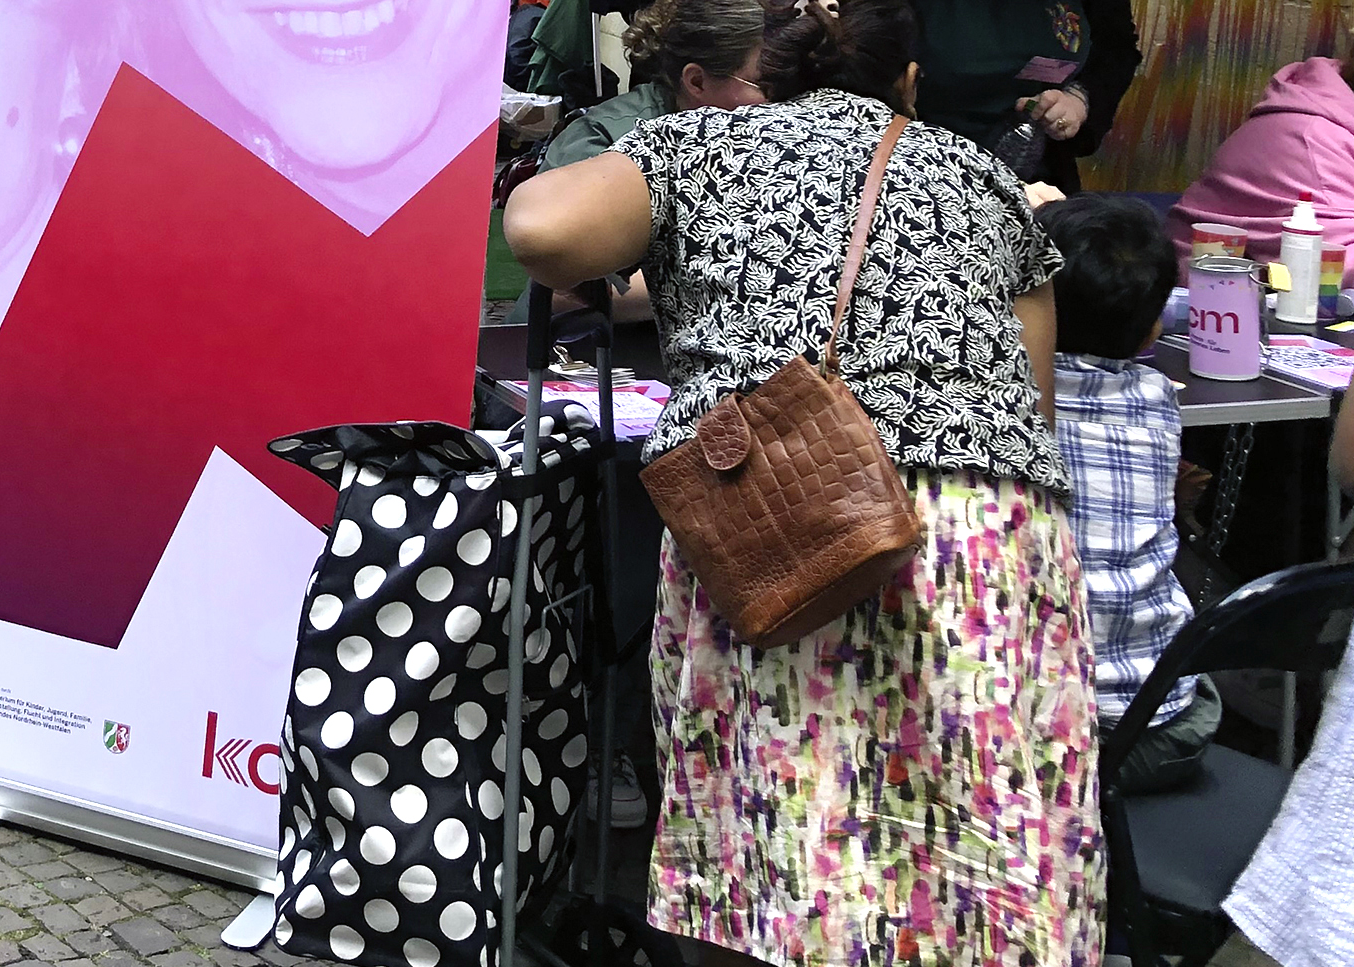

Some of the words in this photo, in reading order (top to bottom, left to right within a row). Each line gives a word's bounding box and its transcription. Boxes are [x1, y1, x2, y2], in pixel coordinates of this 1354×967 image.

[16, 698, 25, 707] für
[23, 708, 42, 719] Flucht
[41, 714, 54, 722] und
[53, 716, 87, 730] Integration
